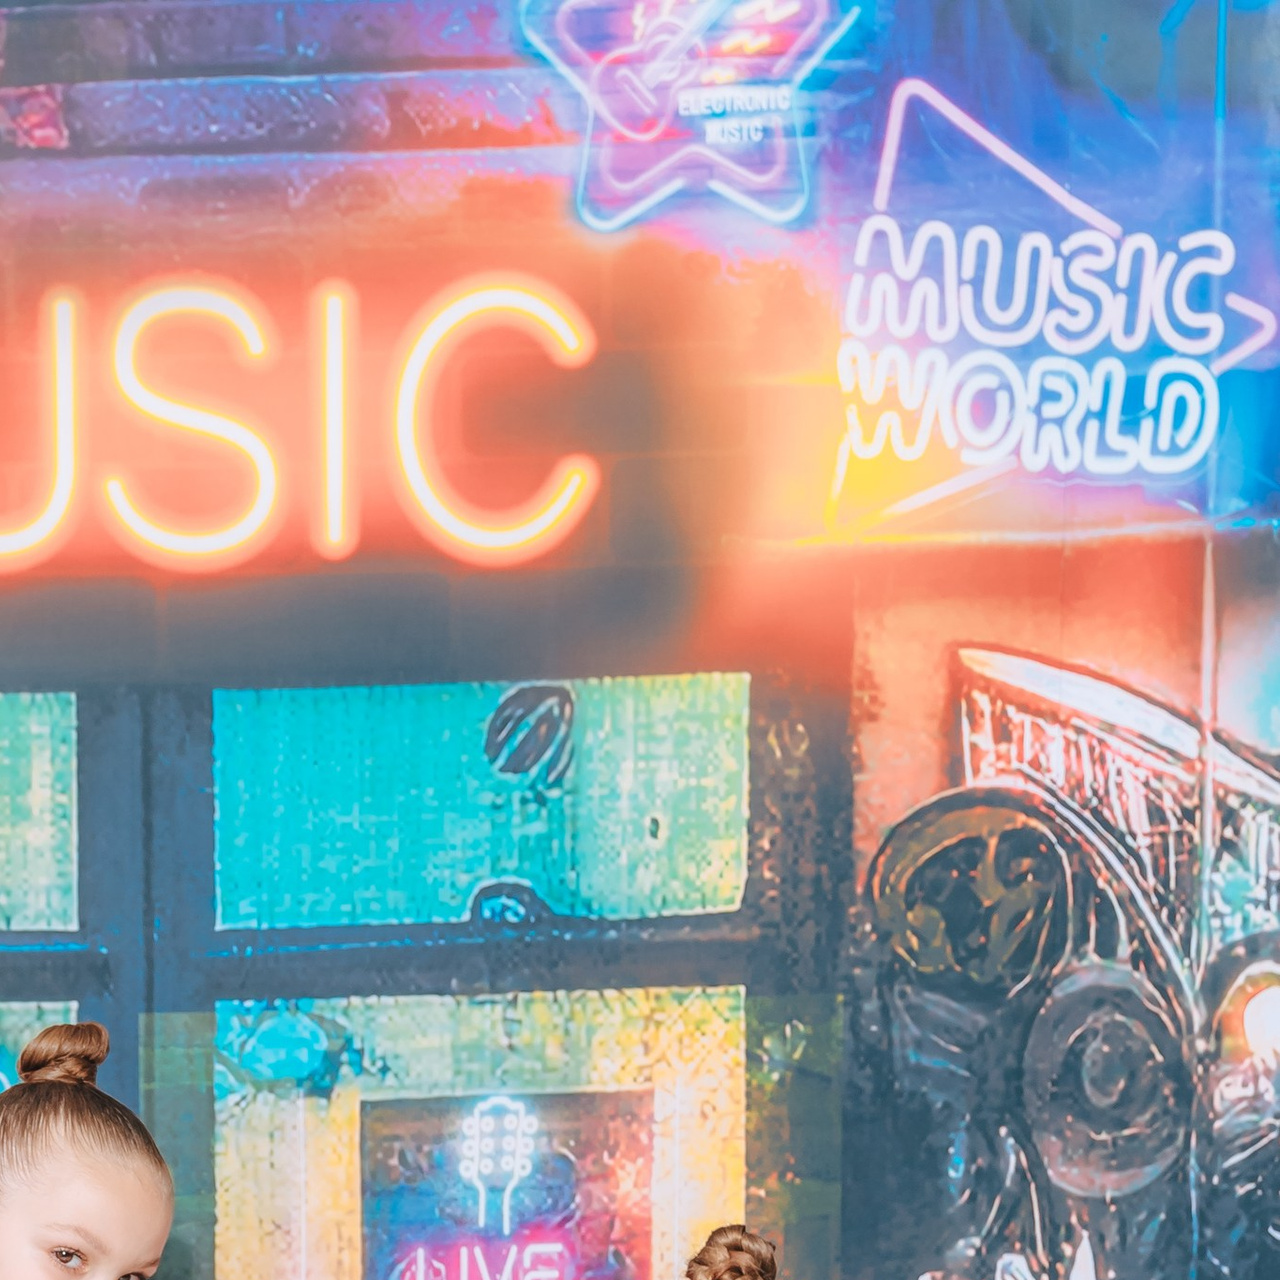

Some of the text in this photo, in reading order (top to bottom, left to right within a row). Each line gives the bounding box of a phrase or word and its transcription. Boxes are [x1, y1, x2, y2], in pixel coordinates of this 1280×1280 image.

[677, 84, 793, 116] ELECTRONIC
[704, 119, 765, 144] MUSIC
[844, 213, 1236, 356] MUSIC
[836, 340, 1220, 474] WORLD
